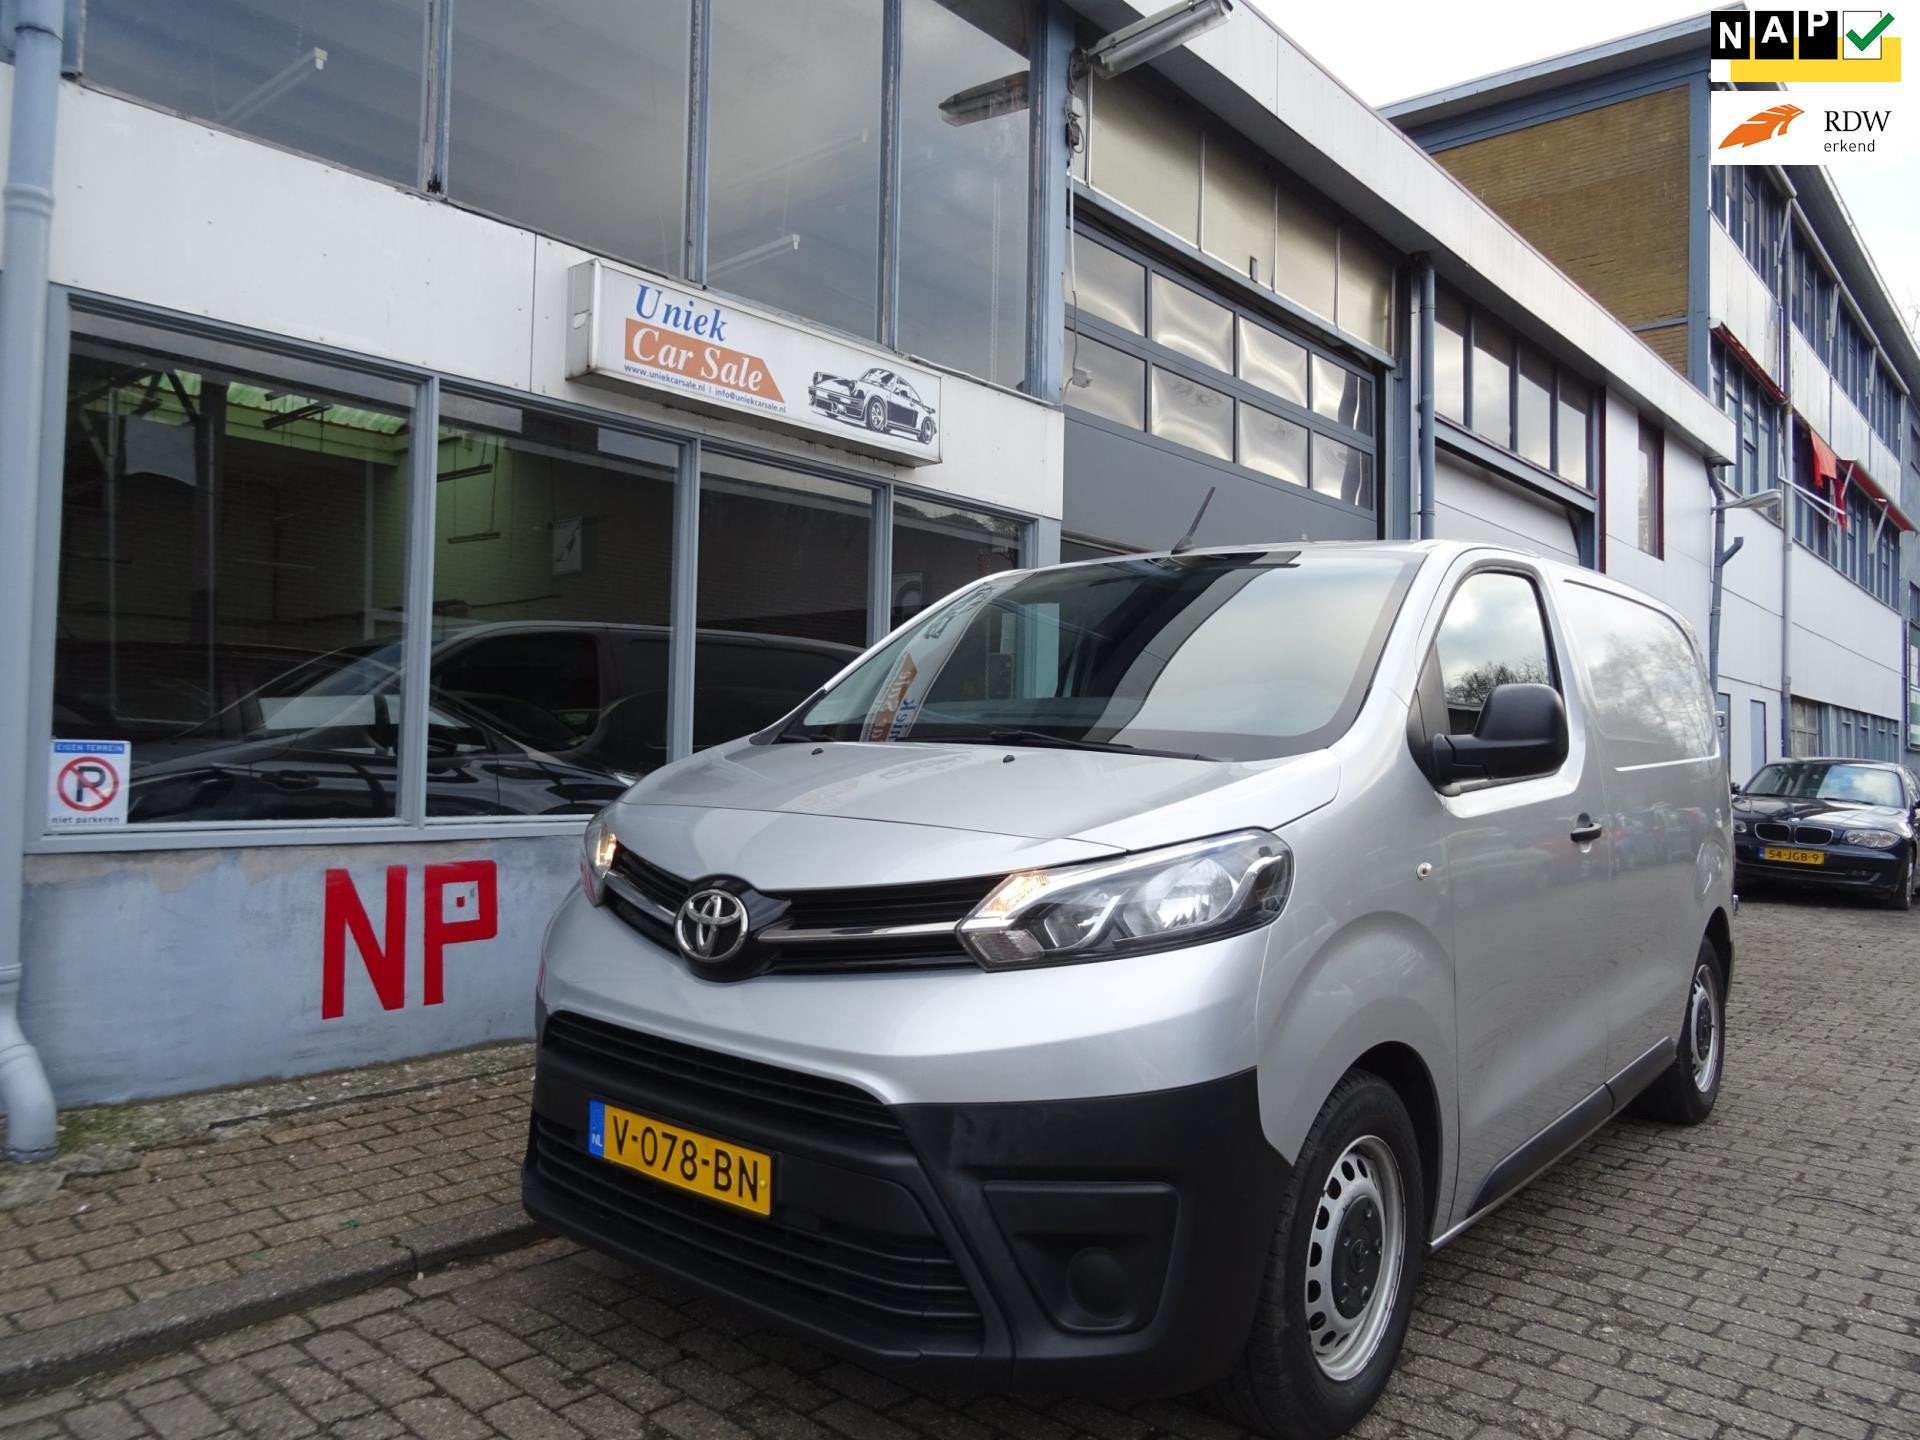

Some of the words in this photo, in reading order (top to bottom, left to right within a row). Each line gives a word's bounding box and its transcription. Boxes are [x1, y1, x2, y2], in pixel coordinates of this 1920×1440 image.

[635, 283, 728, 342] Uniek
[624, 364, 705, 392] www.uniekcarsale.nl
[715, 388, 786, 413] info@uniekcarsale.nl
[632, 327, 694, 371] Car
[700, 346, 763, 391] Sale
[52, 816, 73, 824] niet
[75, 817, 120, 825] parkeren
[322, 860, 498, 1020] NP
[592, 1133, 603, 1147] NL
[613, 1115, 759, 1203] V-078-BN
